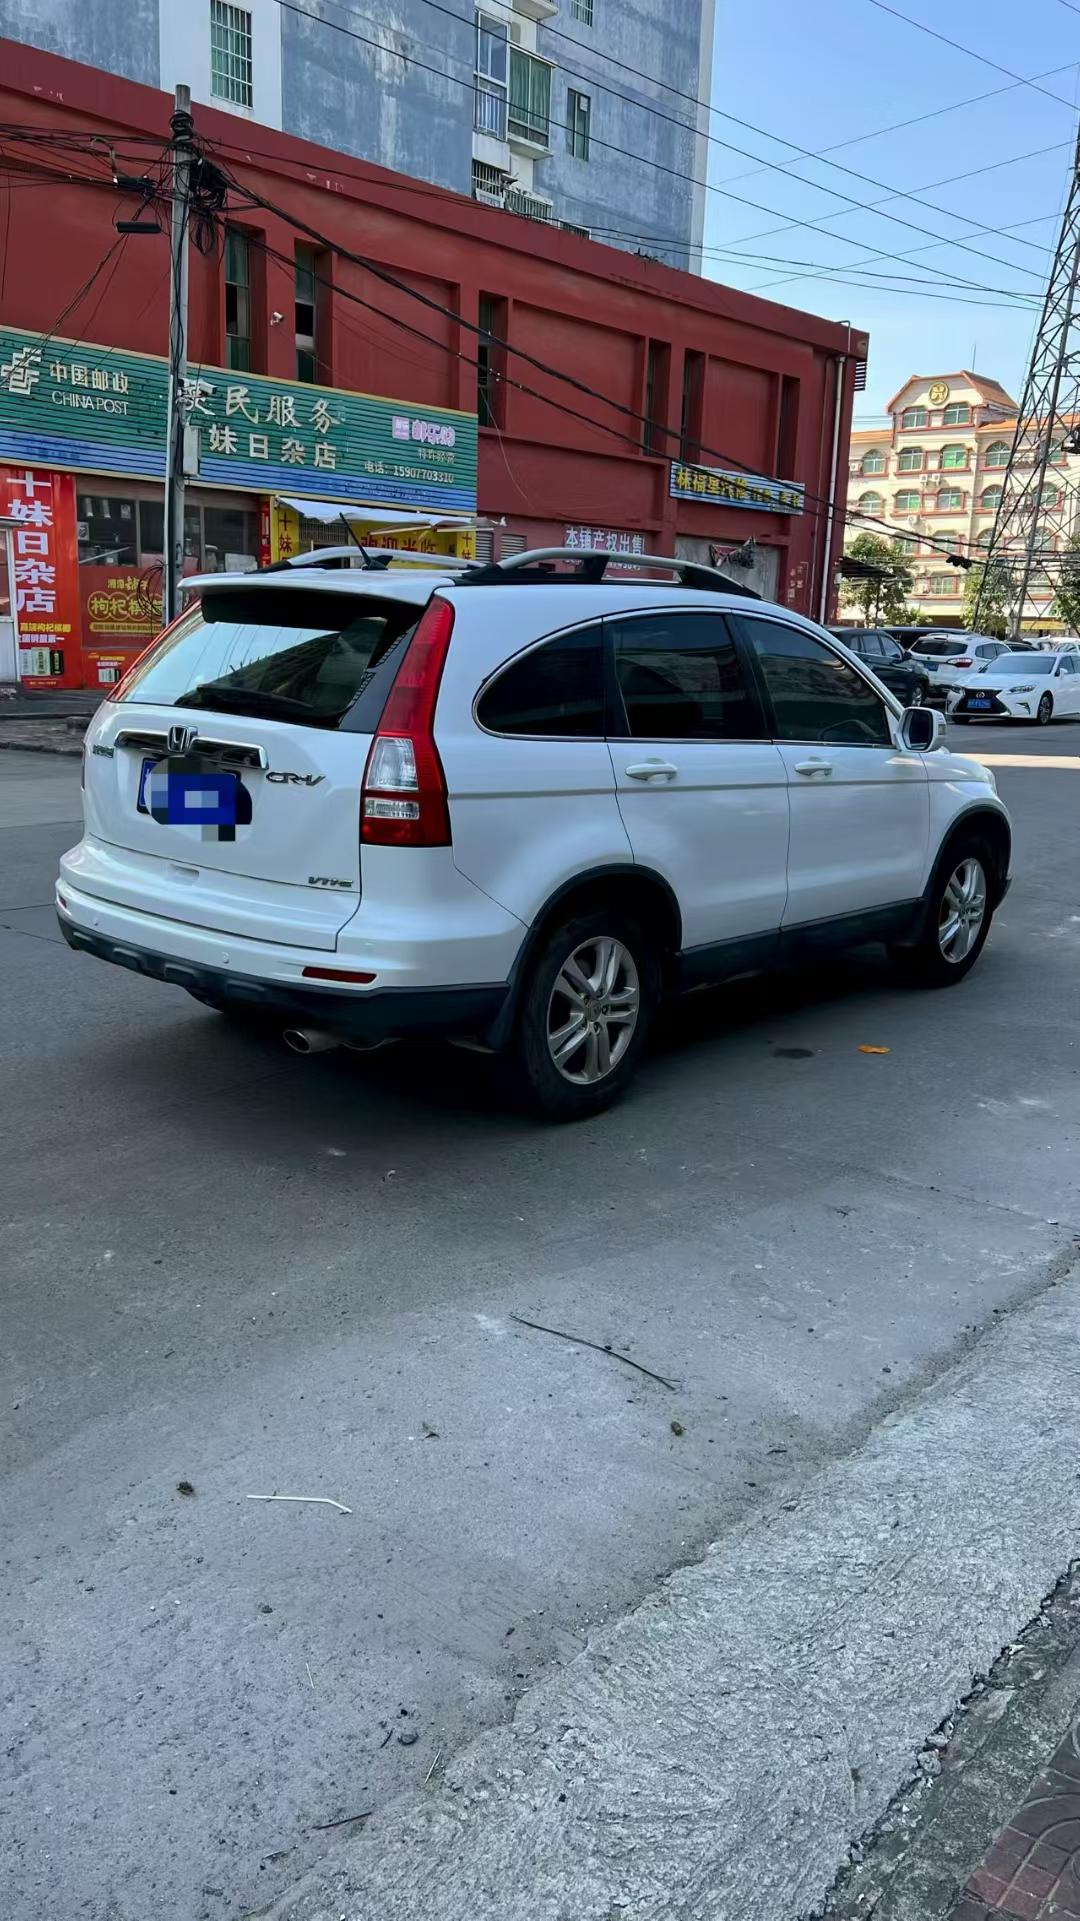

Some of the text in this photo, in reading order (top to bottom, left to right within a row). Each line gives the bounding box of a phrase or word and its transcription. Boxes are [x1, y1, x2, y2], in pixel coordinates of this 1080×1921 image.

[50, 360, 129, 395] 中国邮政
[52, 390, 129, 415] CHINA POST
[208, 423, 336, 470] 妹日杂店
[6, 471, 56, 613] 十妹日杂店
[279, 511, 293, 560] 十妹
